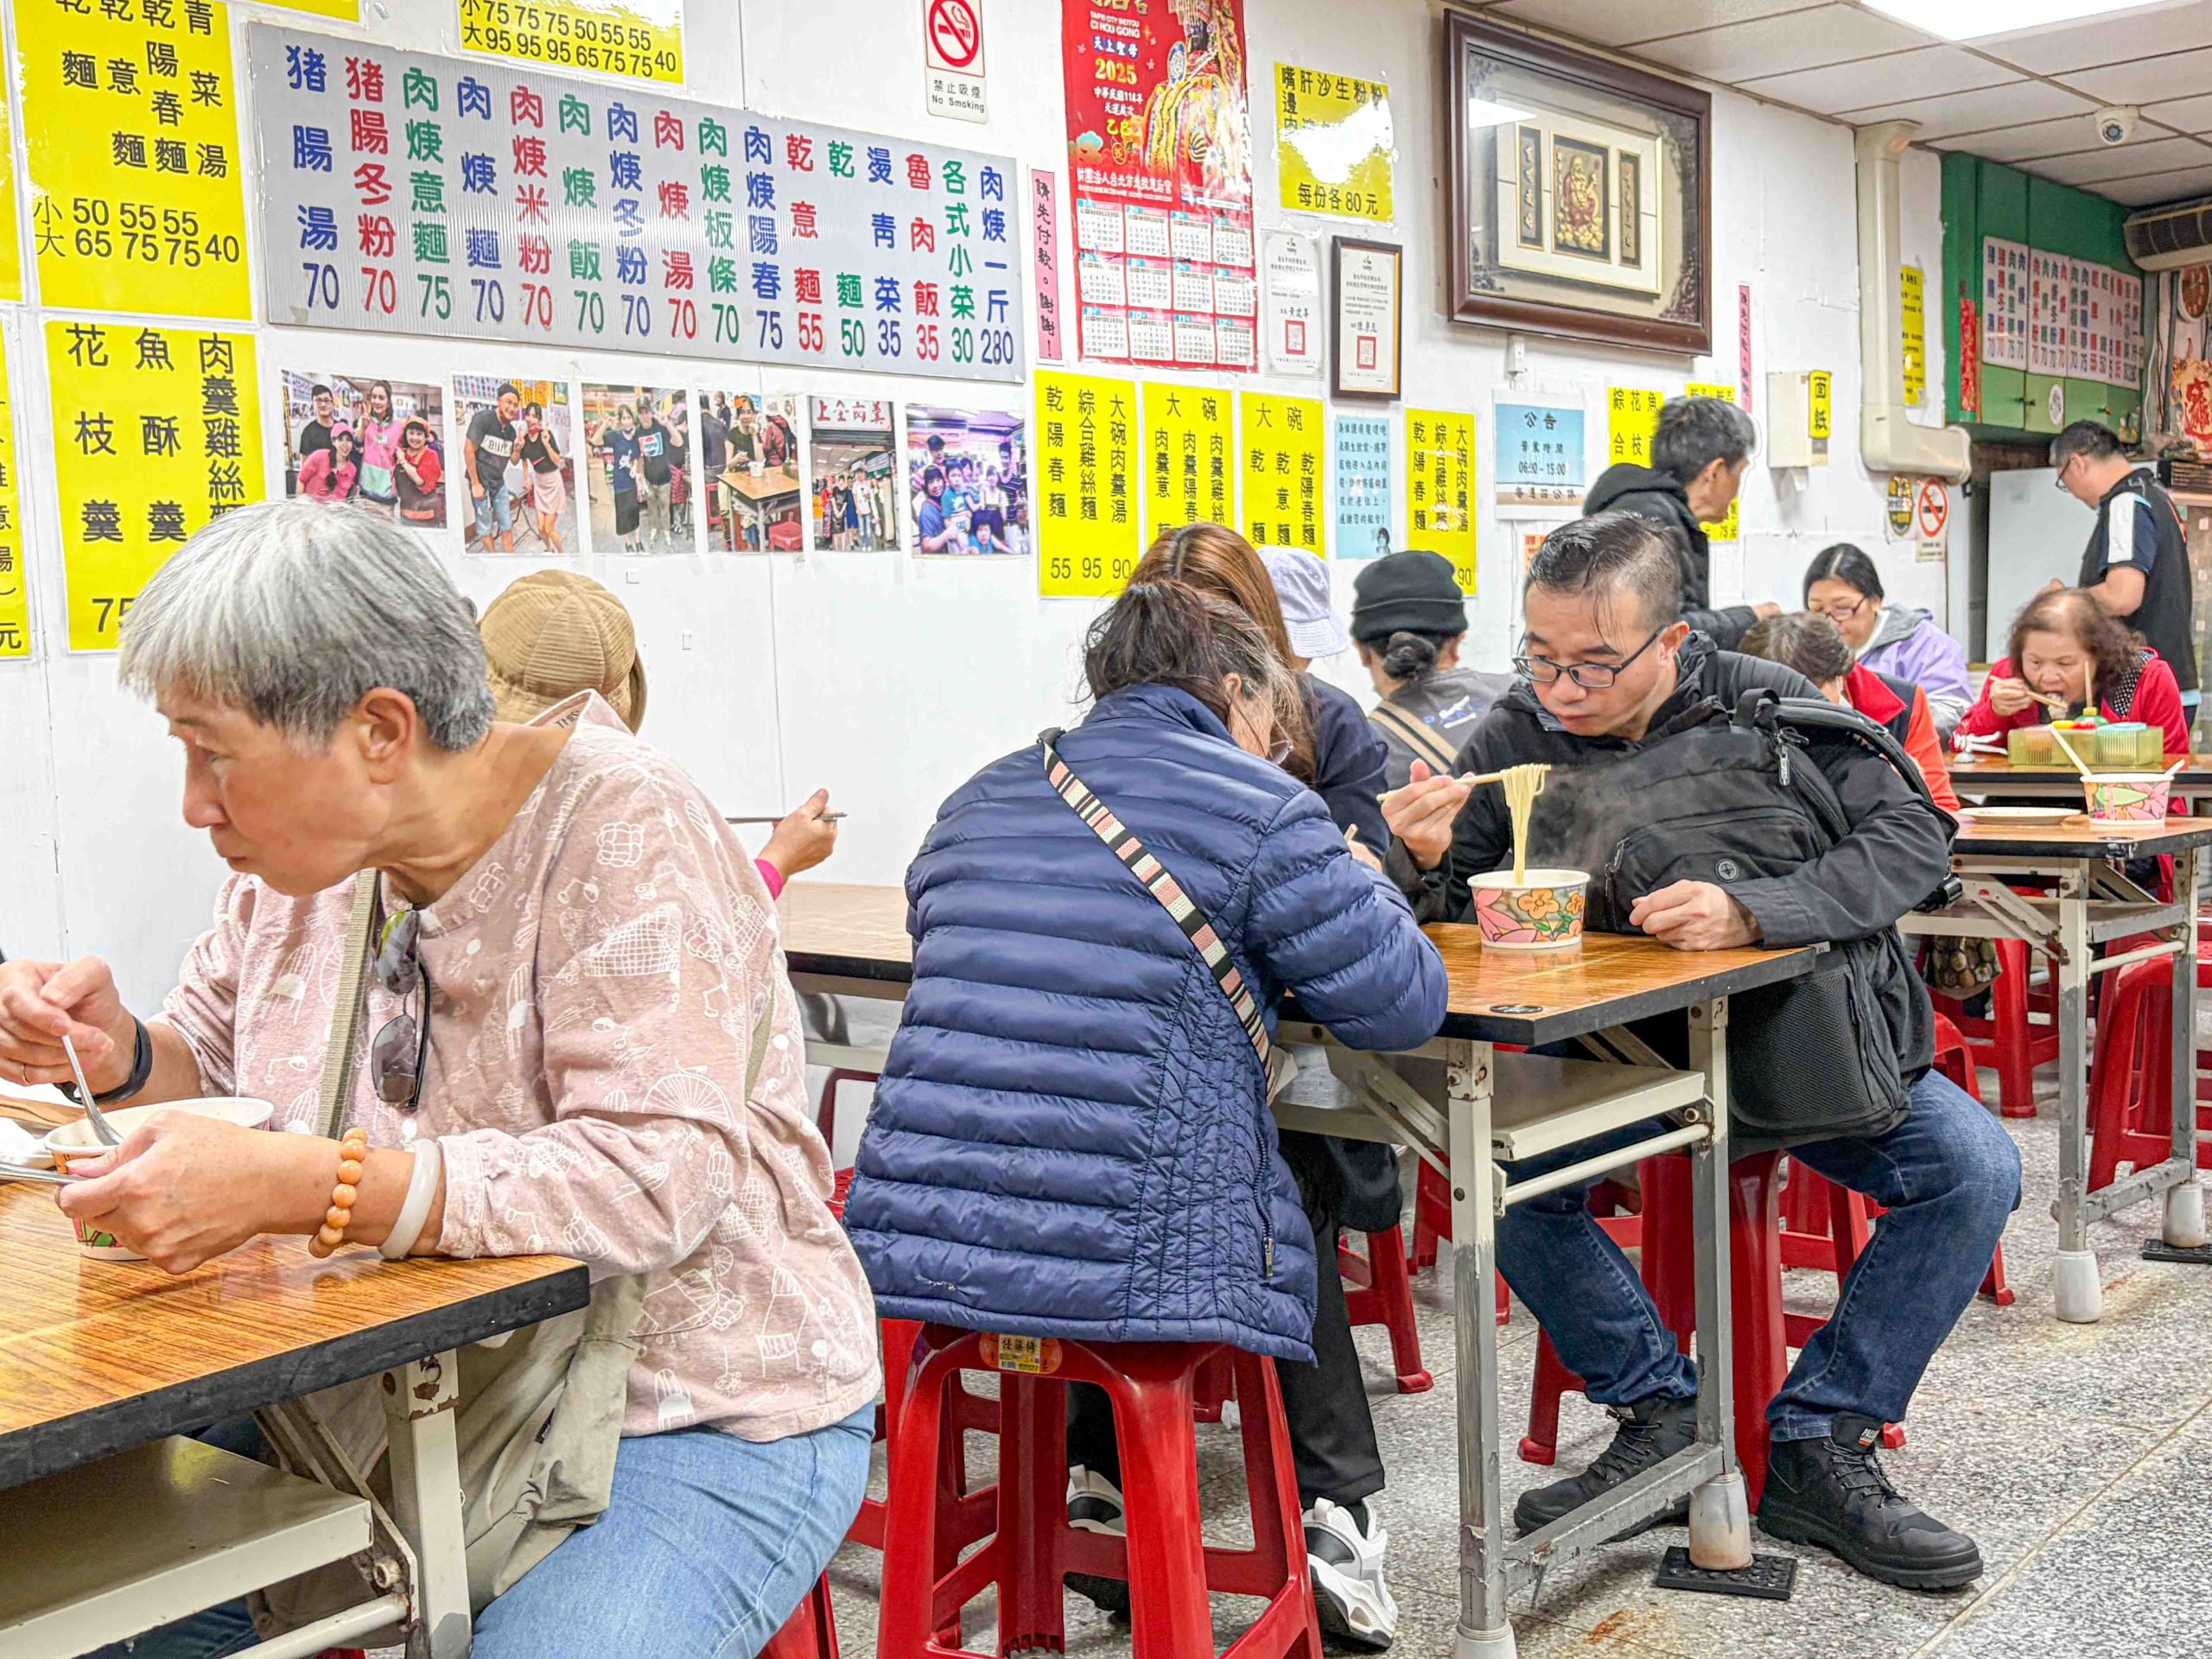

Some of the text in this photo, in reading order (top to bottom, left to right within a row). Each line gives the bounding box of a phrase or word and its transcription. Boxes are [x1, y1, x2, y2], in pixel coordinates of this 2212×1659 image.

[486, 1, 509, 24] 75
[516, 6, 539, 29] 75
[544, 12, 569, 35] 75
[575, 19, 596, 41] 50
[601, 22, 623, 46] 55
[629, 28, 651, 51] 55
[1116, 26, 1140, 38] GONG
[464, 23, 676, 77] 大 95 95 95 65 75 75 40
[184, 0, 227, 178] 青菜湯
[1095, 58, 1137, 85] 2025
[932, 94, 984, 113] No Smoking
[34, 195, 199, 237] 小 50 55 55
[35, 227, 239, 267] 大 65 75 75 40
[786, 134, 823, 352] 乾意麵 55
[828, 140, 864, 357] 乾麵 50
[906, 154, 939, 360] 魯肉飯 35
[943, 161, 975, 364] 各式小菜 30
[303, 264, 339, 309] 70
[361, 267, 397, 314] 70
[417, 274, 451, 320] 75
[471, 278, 504, 322] 70
[522, 283, 552, 327] 70
[574, 290, 604, 334] 70
[621, 295, 650, 336] 70
[668, 298, 696, 339] 70
[711, 304, 739, 343] 70
[757, 310, 782, 349] 75
[878, 320, 900, 357] 35
[981, 329, 1014, 365] 280
[1524, 411, 1556, 430] 公告
[1046, 385, 1071, 578] 乾陽春麵 55
[1082, 557, 1102, 579] 95
[1112, 558, 1130, 579] 90
[1458, 568, 1471, 586] 90
